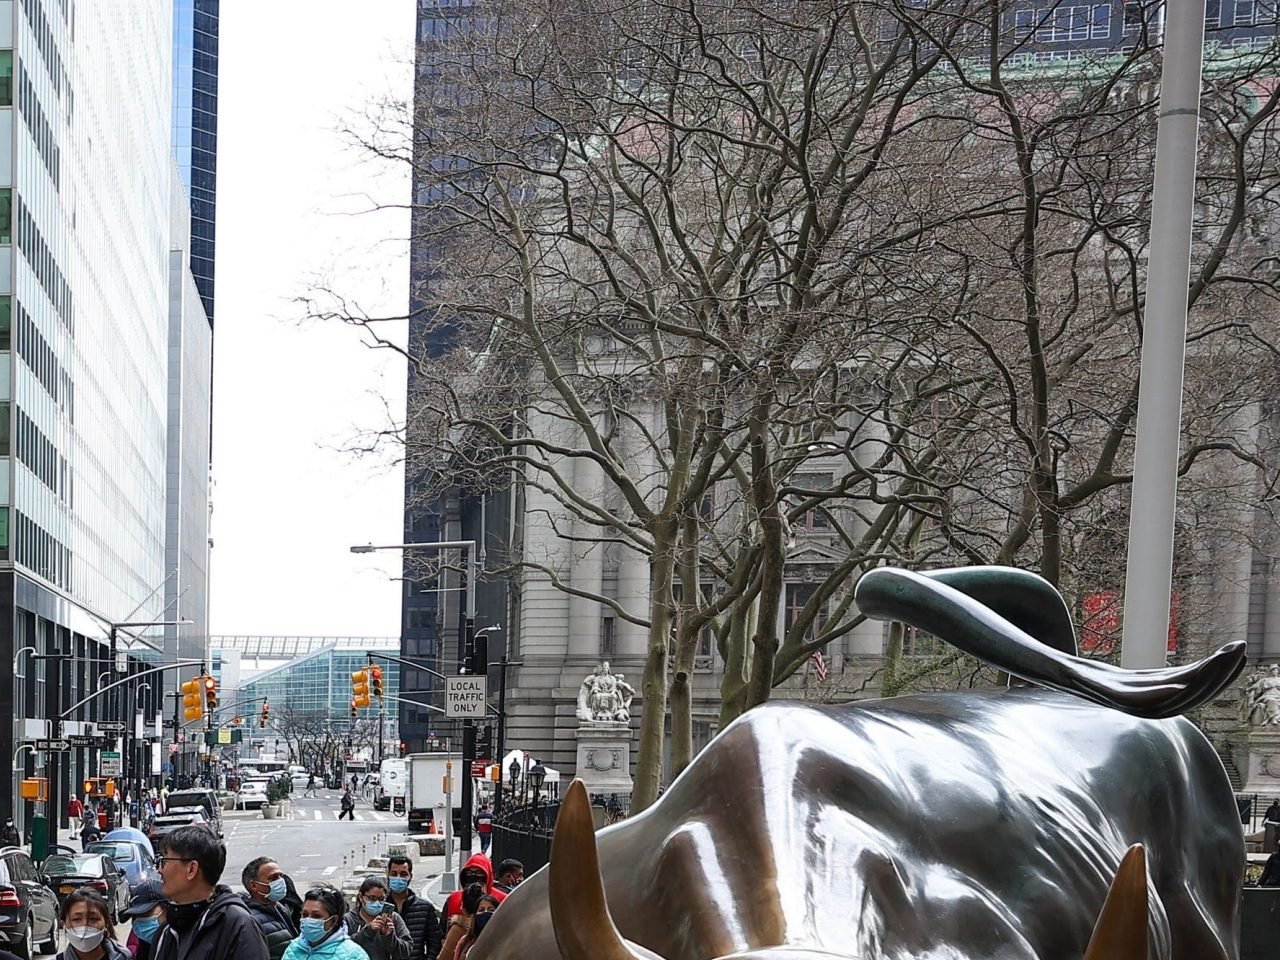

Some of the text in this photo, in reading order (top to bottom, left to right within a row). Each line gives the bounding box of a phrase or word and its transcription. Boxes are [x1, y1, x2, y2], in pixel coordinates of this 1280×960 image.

[450, 682, 481, 691] LOCAL
[448, 692, 484, 701] TRAFFIC
[453, 703, 478, 712] ONLY
